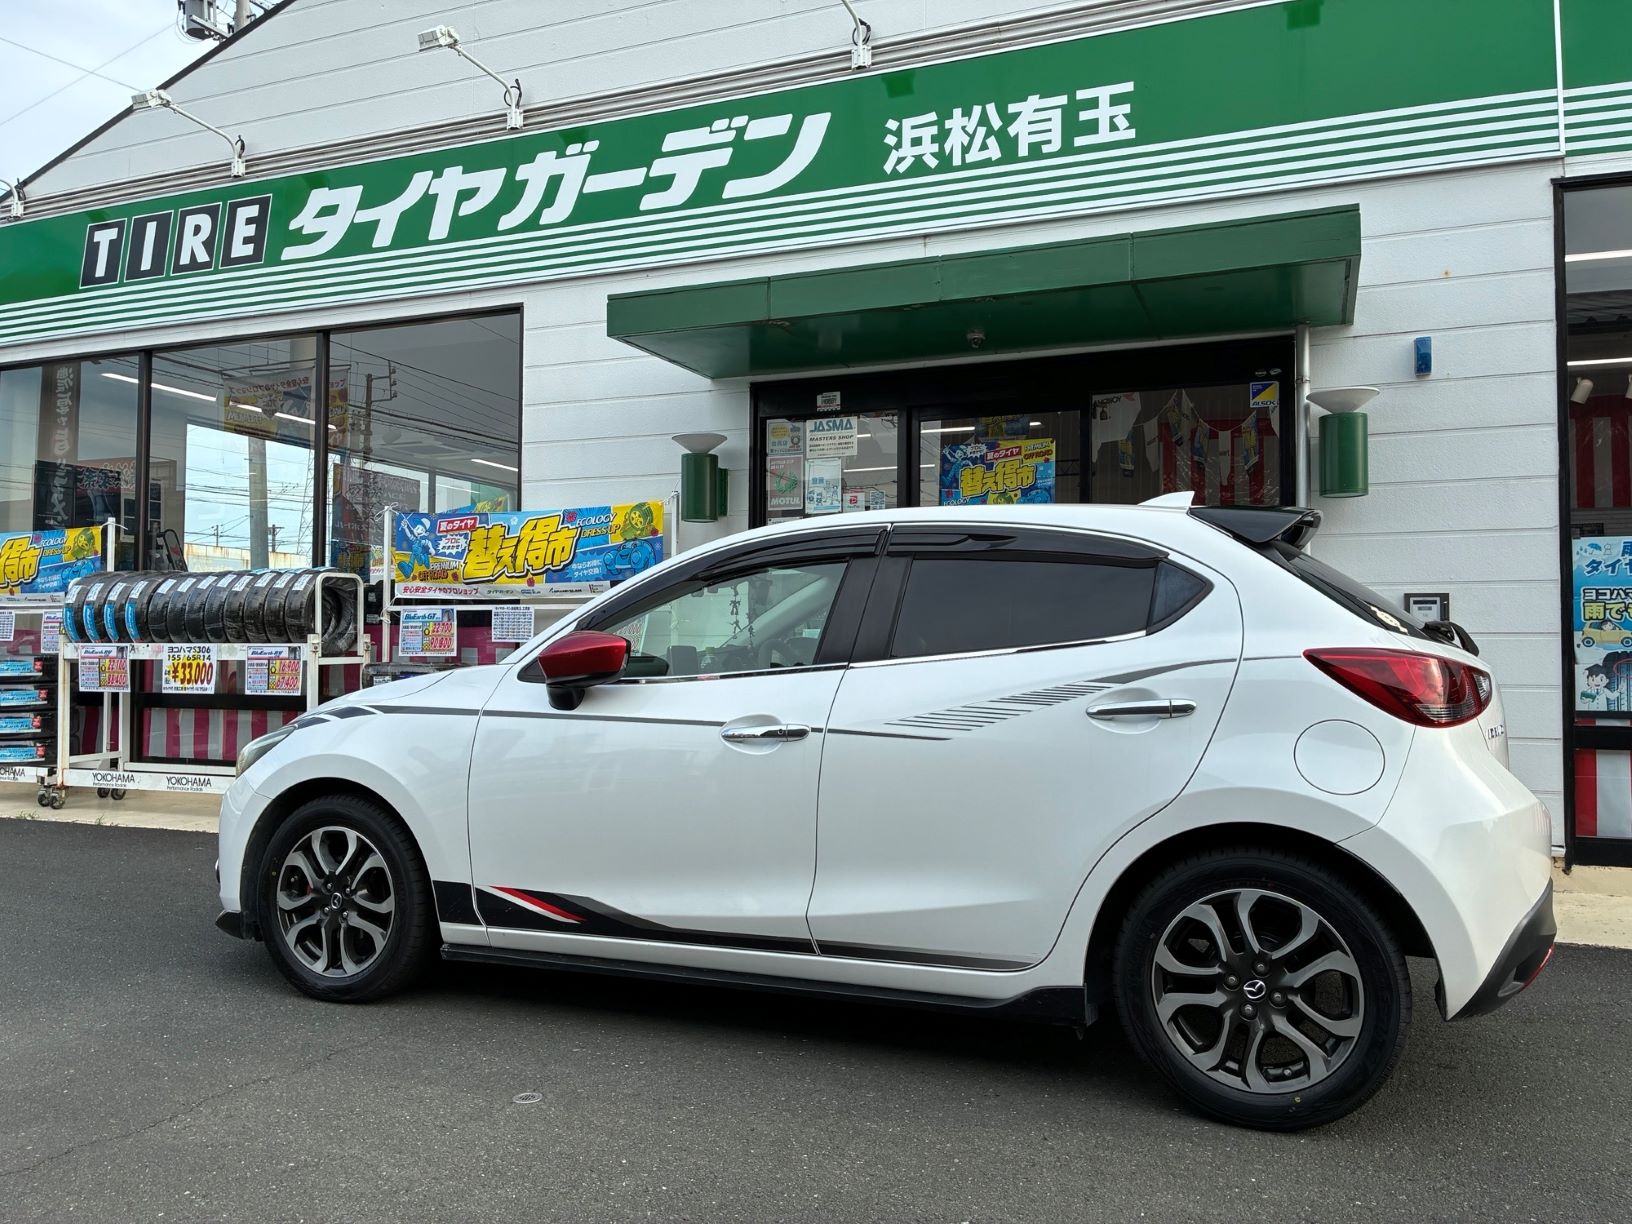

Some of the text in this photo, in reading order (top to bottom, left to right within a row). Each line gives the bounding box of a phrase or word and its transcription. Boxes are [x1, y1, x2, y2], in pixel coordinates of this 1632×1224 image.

[92, 80, 1136, 278] TIRE タイヤガーデン 浜松有玉
[809, 418, 854, 433] JASMA
[986, 447, 1020, 460] 夏のタイヤ
[960, 459, 1035, 497] 替え得市
[771, 496, 801, 505] MOTUL
[440, 519, 475, 532] 夏のタイヤ
[576, 513, 617, 527] ECOLOGY
[463, 515, 578, 580] 替え得市
[402, 585, 480, 595] 安心安全タイヤのプロショップ
[1583, 602, 1632, 620] 雨で
[167, 646, 211, 654] ヨコハマS306
[171, 661, 214, 686] ¥33,000
[92, 772, 135, 784] YOKOHAMA
[166, 776, 212, 787] YOKOHAMA
